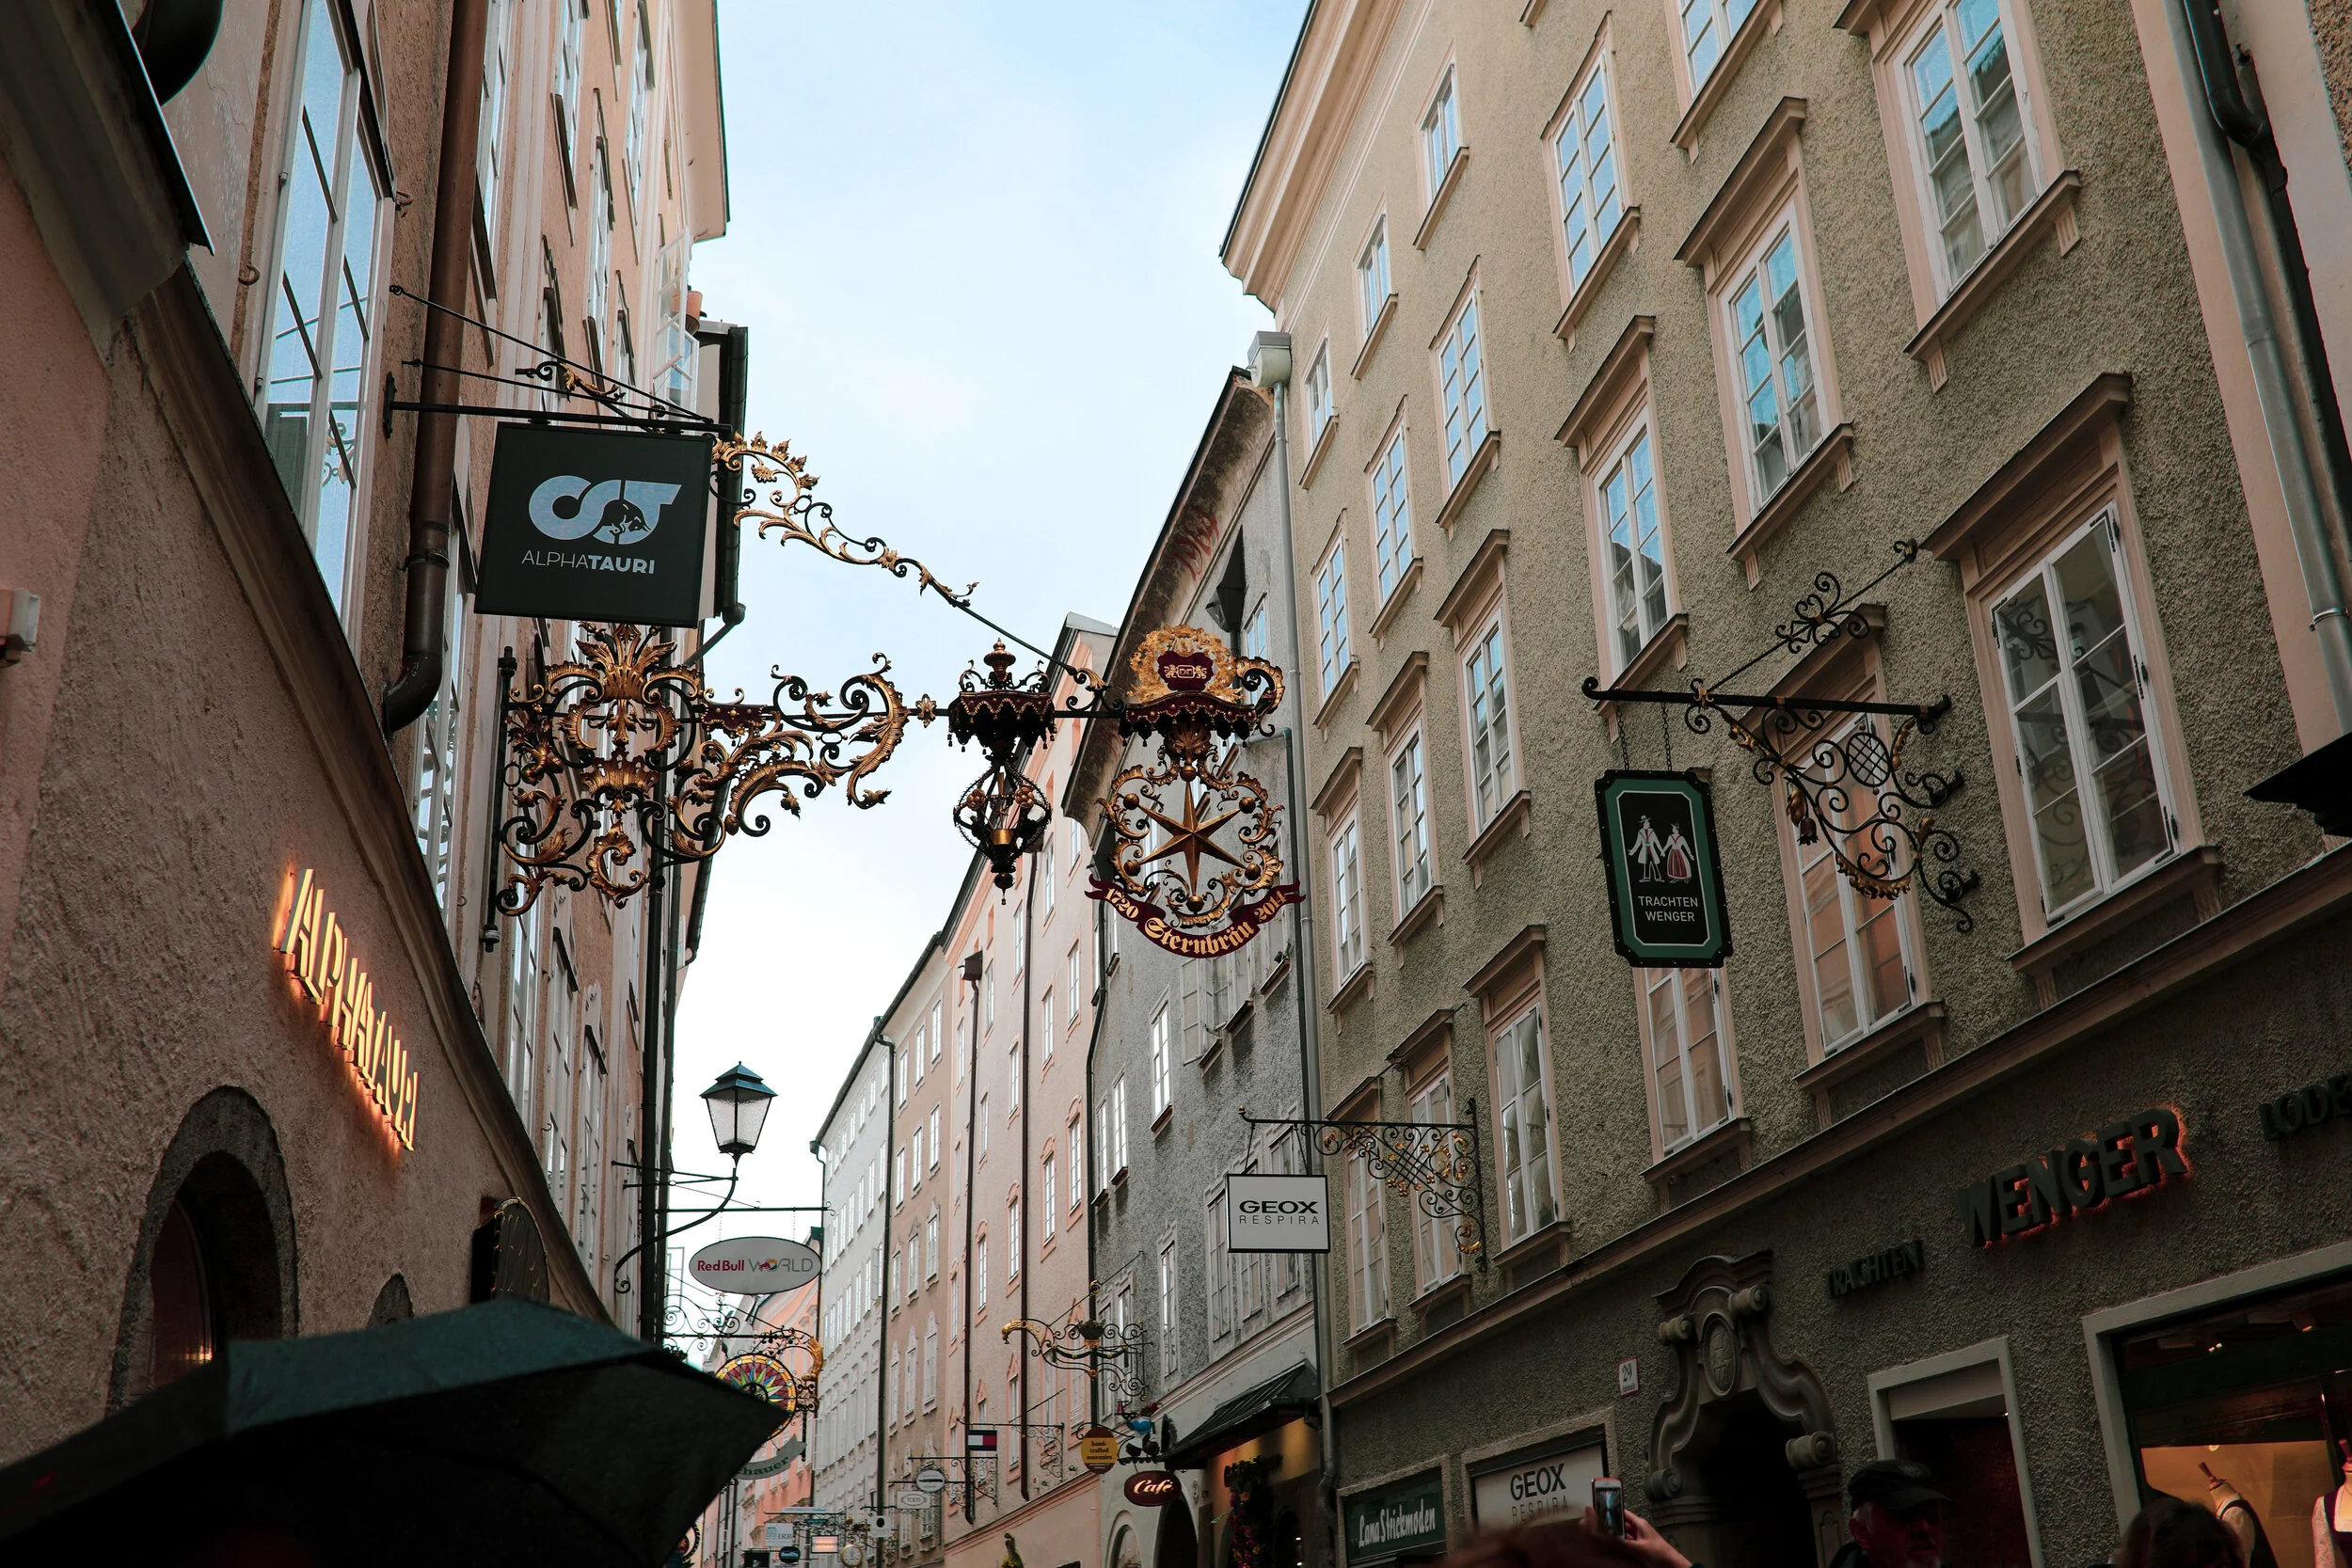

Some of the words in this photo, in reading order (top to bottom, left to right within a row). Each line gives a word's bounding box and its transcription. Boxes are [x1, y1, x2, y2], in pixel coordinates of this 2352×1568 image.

[521, 549, 656, 575] ALPHATAURI
[1104, 887, 1140, 920] 1720
[1253, 890, 1288, 922] 2014
[1637, 895, 1699, 908] TRACHTEN
[1645, 911, 1695, 922] WENGER
[1144, 917, 1255, 956] Sternbräu
[1958, 1107, 2187, 1247] WENGER
[1239, 1199, 1319, 1214] GEOX
[1239, 1214, 1320, 1225] RESPIRA
[748, 1258, 814, 1273] WORLD
[1621, 1363, 1632, 1383] 29
[1509, 1463, 1566, 1501] GEOX
[1380, 1497, 1437, 1544] Strickmoden
[1511, 1495, 1569, 1526] RESPIRA
